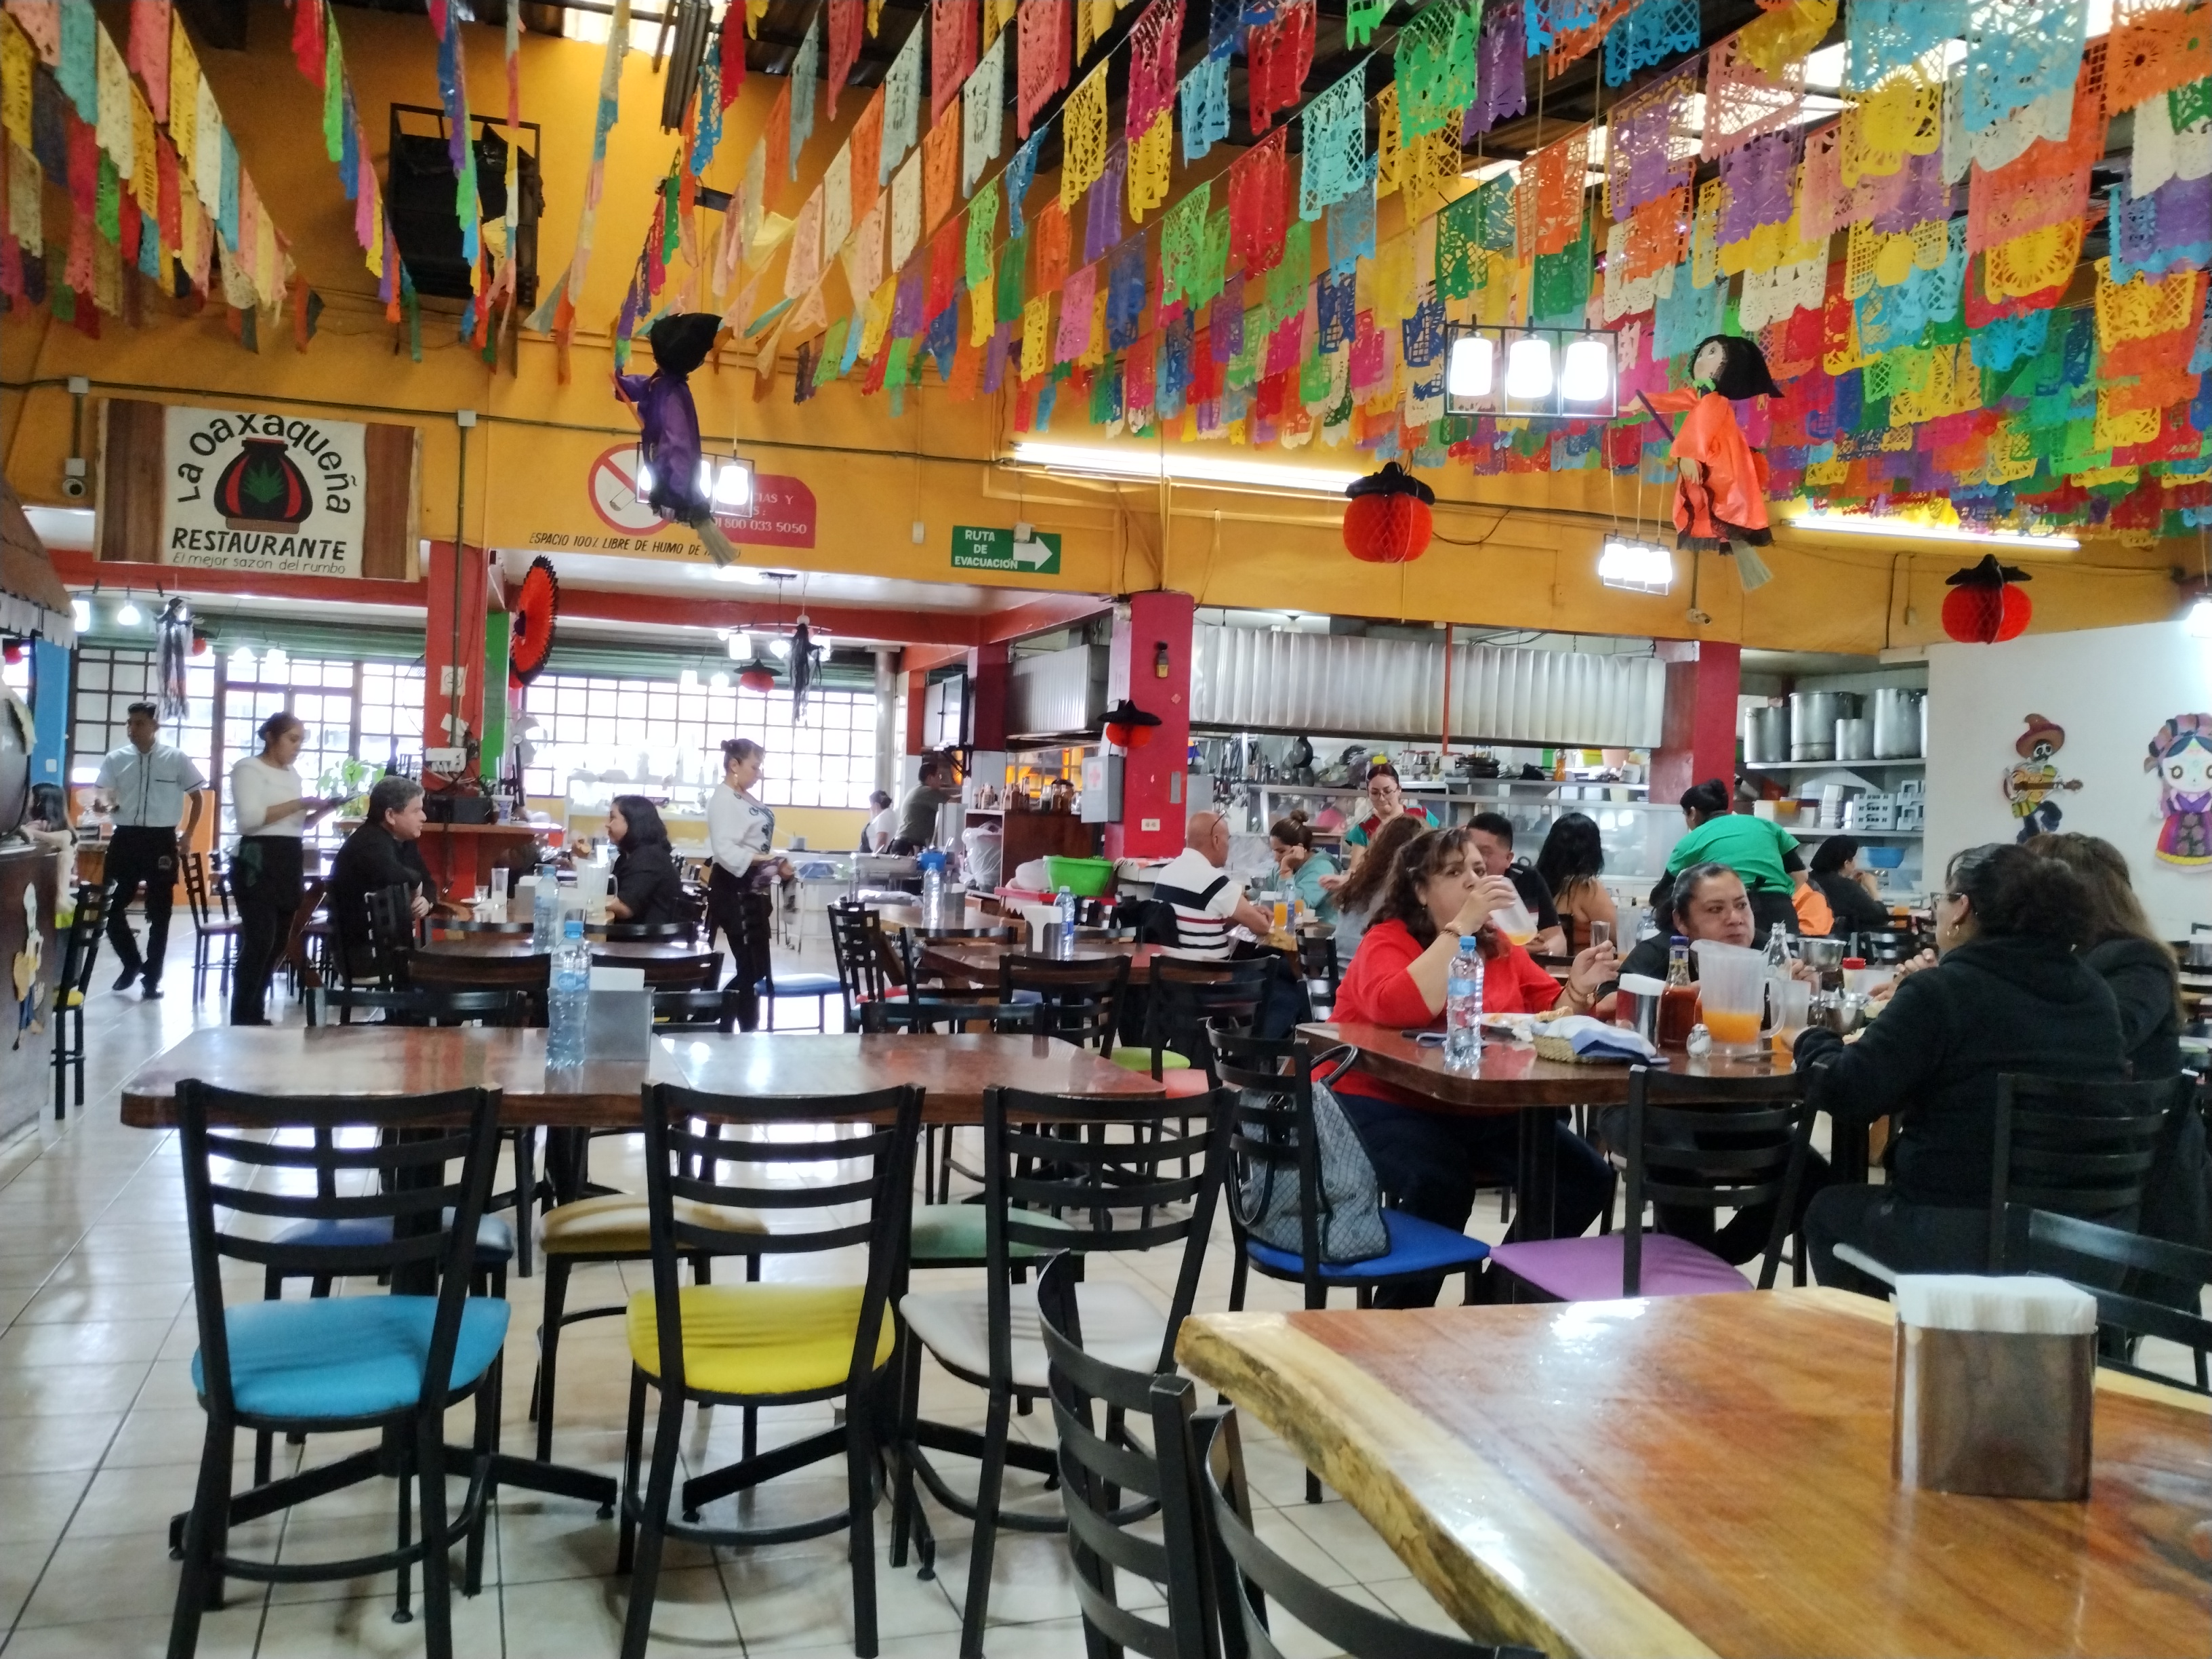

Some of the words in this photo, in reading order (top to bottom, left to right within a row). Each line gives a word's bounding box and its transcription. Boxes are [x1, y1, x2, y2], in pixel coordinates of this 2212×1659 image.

[190, 413, 357, 514] Oaxaqueña
[178, 463, 204, 502] La
[724, 518, 747, 529] 800
[750, 520, 773, 532] 033
[776, 522, 807, 534] 5050
[964, 529, 995, 541] RUTA
[171, 527, 347, 561] RESTAURANTE
[529, 532, 569, 546] ESPACIO
[602, 537, 630, 550] LIBRE
[634, 539, 647, 552] DE
[652, 541, 684, 555] HUMO
[687, 544, 700, 556] DE
[973, 544, 988, 554] DE
[173, 552, 184, 564] El
[188, 554, 228, 567] mejor
[233, 556, 272, 569] sazón
[279, 558, 299, 571] del
[303, 560, 346, 574] rumbo
[954, 555, 1018, 569] EVACUACIÓN
